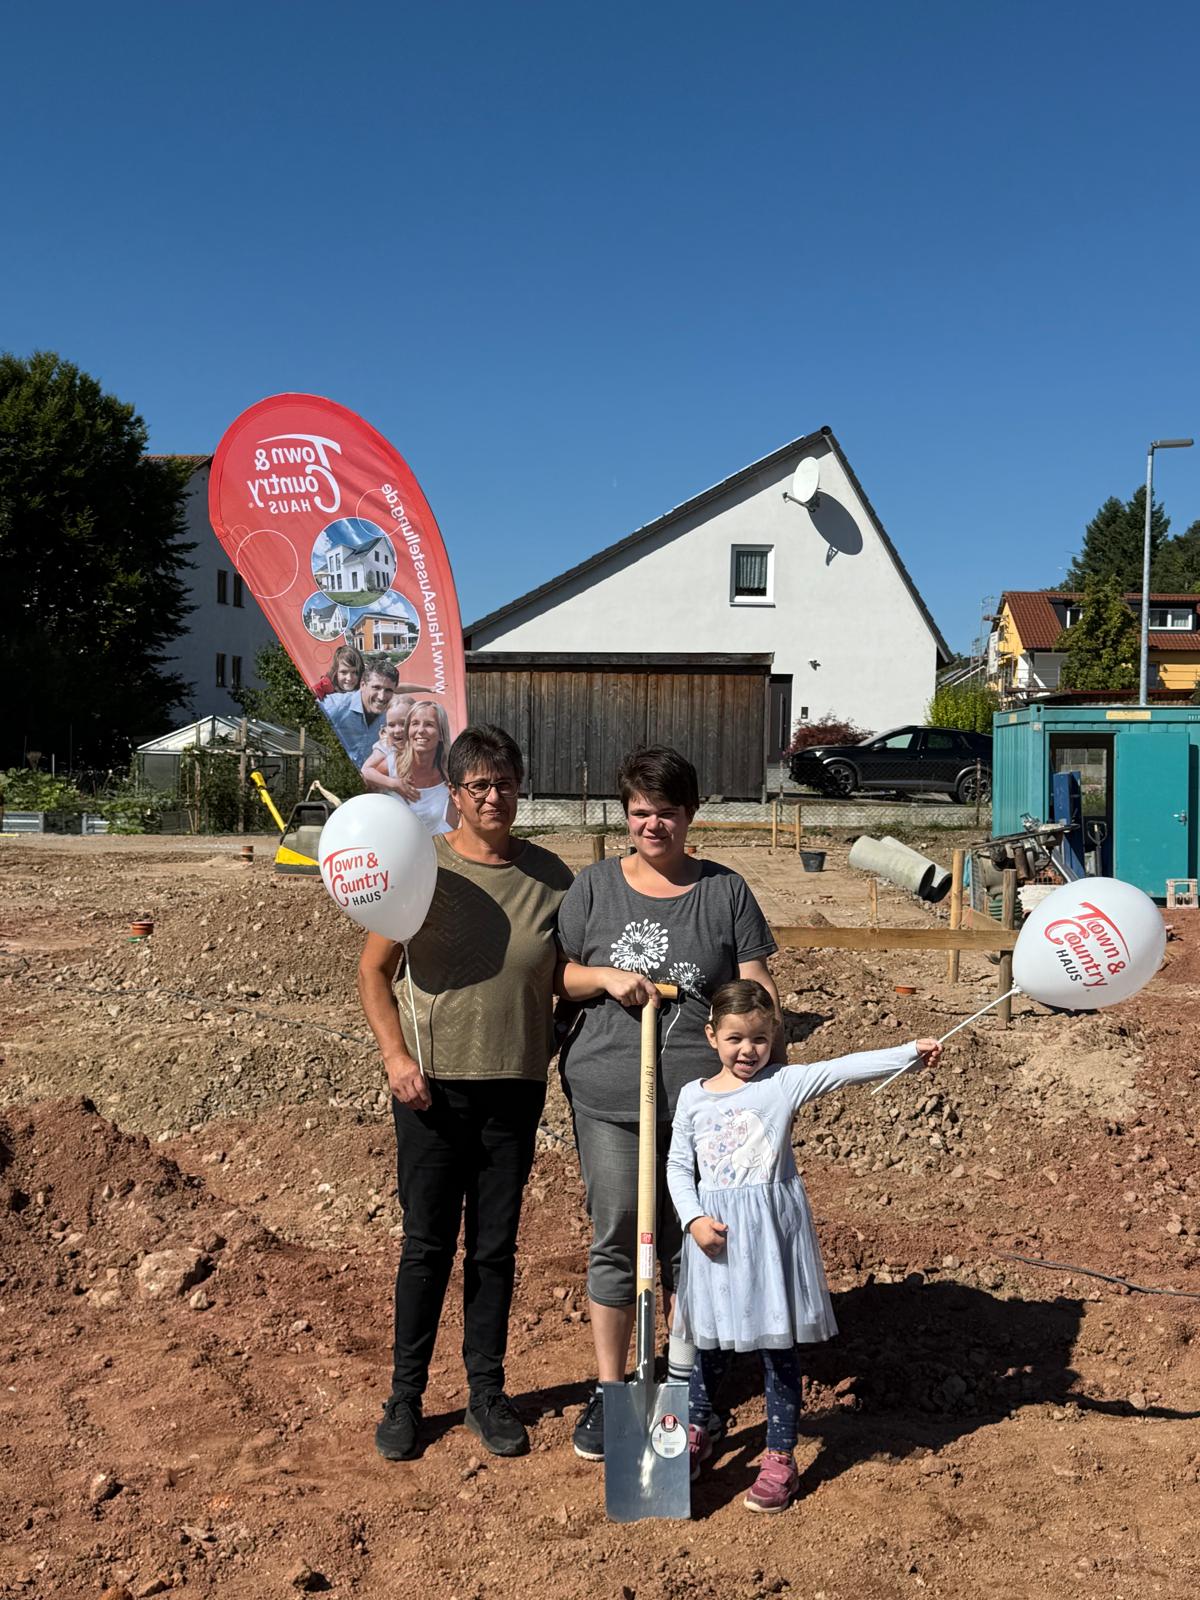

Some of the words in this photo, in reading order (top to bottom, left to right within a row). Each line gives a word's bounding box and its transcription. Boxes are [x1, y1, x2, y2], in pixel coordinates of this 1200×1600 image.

[323, 846, 371, 880] Town
[366, 852, 379, 869] &
[332, 870, 389, 907] Country
[352, 891, 382, 906] HAUS
[1044, 919, 1108, 988] Country
[1072, 901, 1131, 961] Town
[1107, 960, 1126, 975] &
[1055, 949, 1082, 982] HAUS
